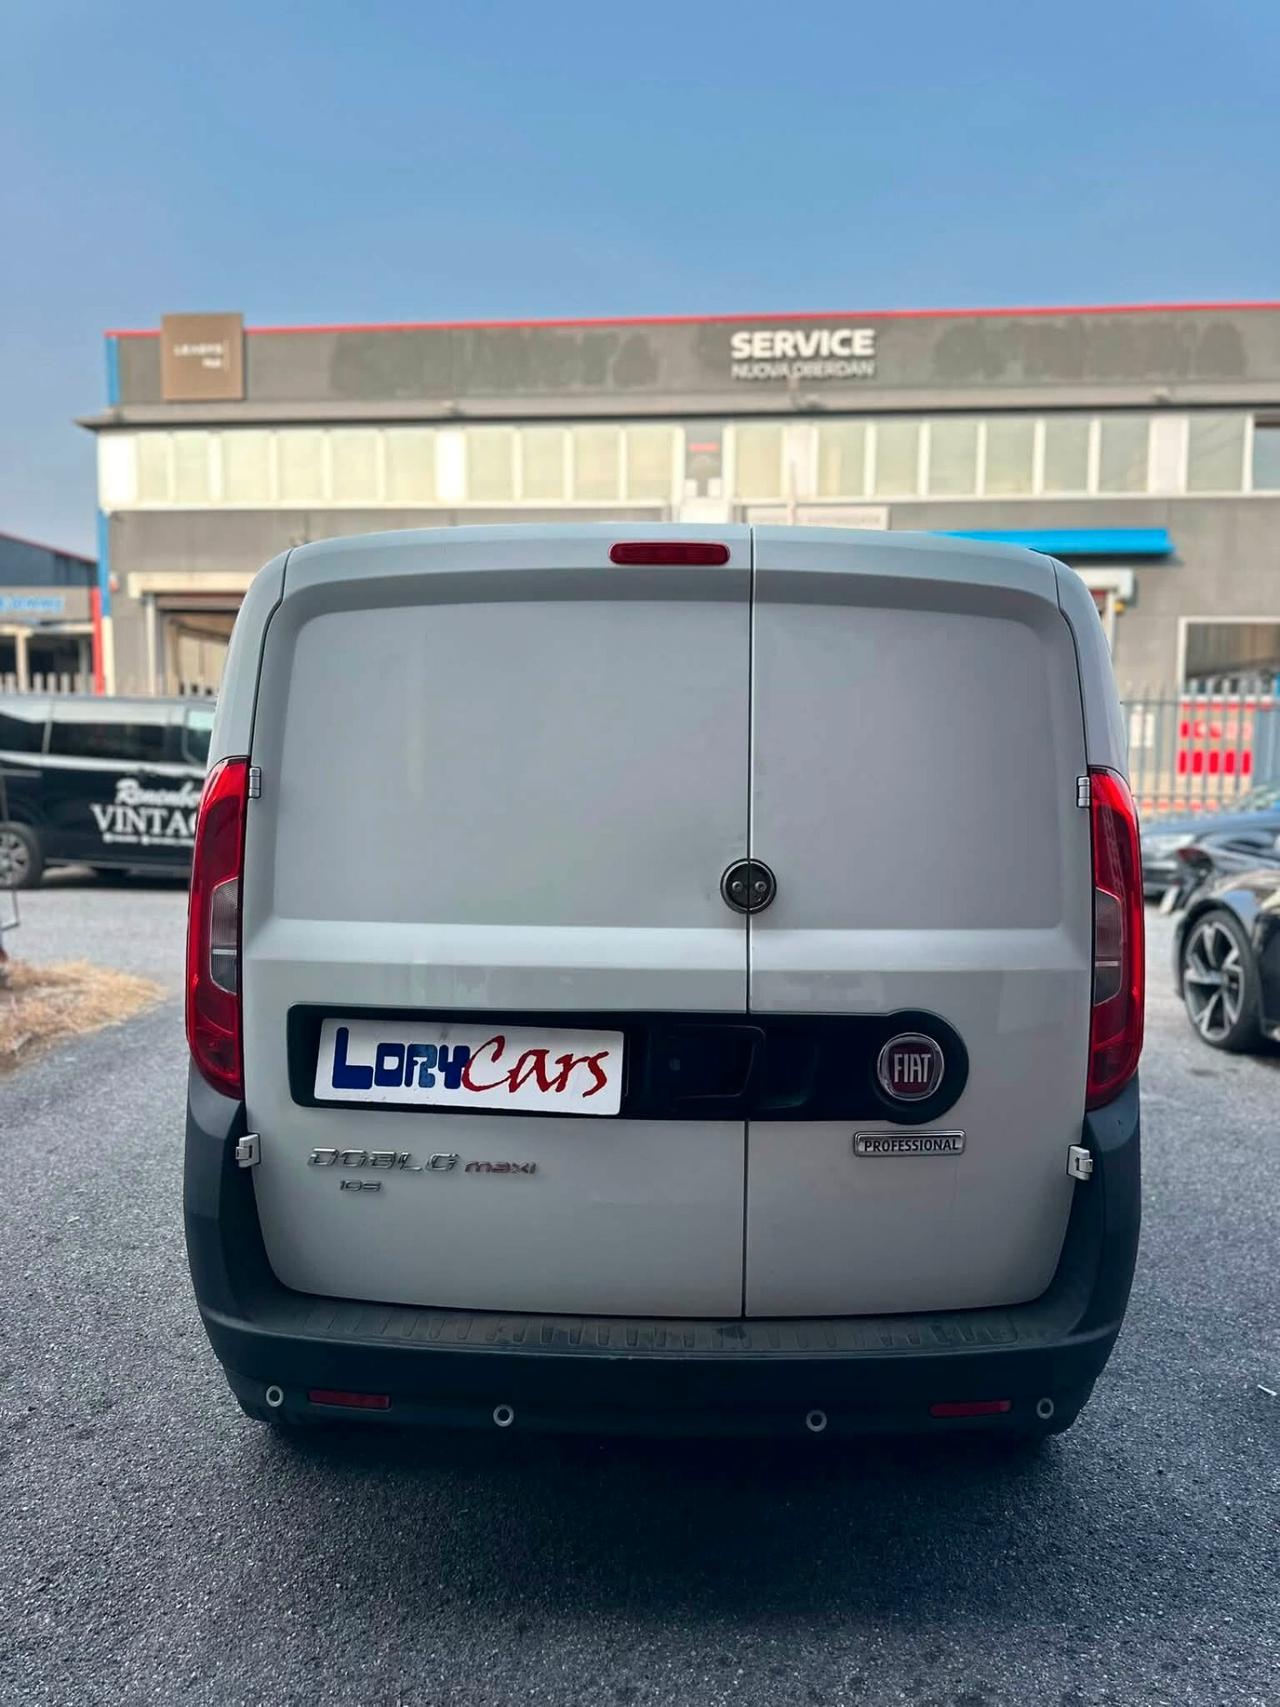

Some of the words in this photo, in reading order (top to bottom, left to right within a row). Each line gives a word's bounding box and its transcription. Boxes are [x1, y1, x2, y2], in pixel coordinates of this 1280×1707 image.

[731, 329, 875, 359] SERVICE
[732, 361, 788, 379] NUOVA
[893, 1053, 932, 1083] FIAT
[864, 1139, 959, 1153] PROFESSIONAL
